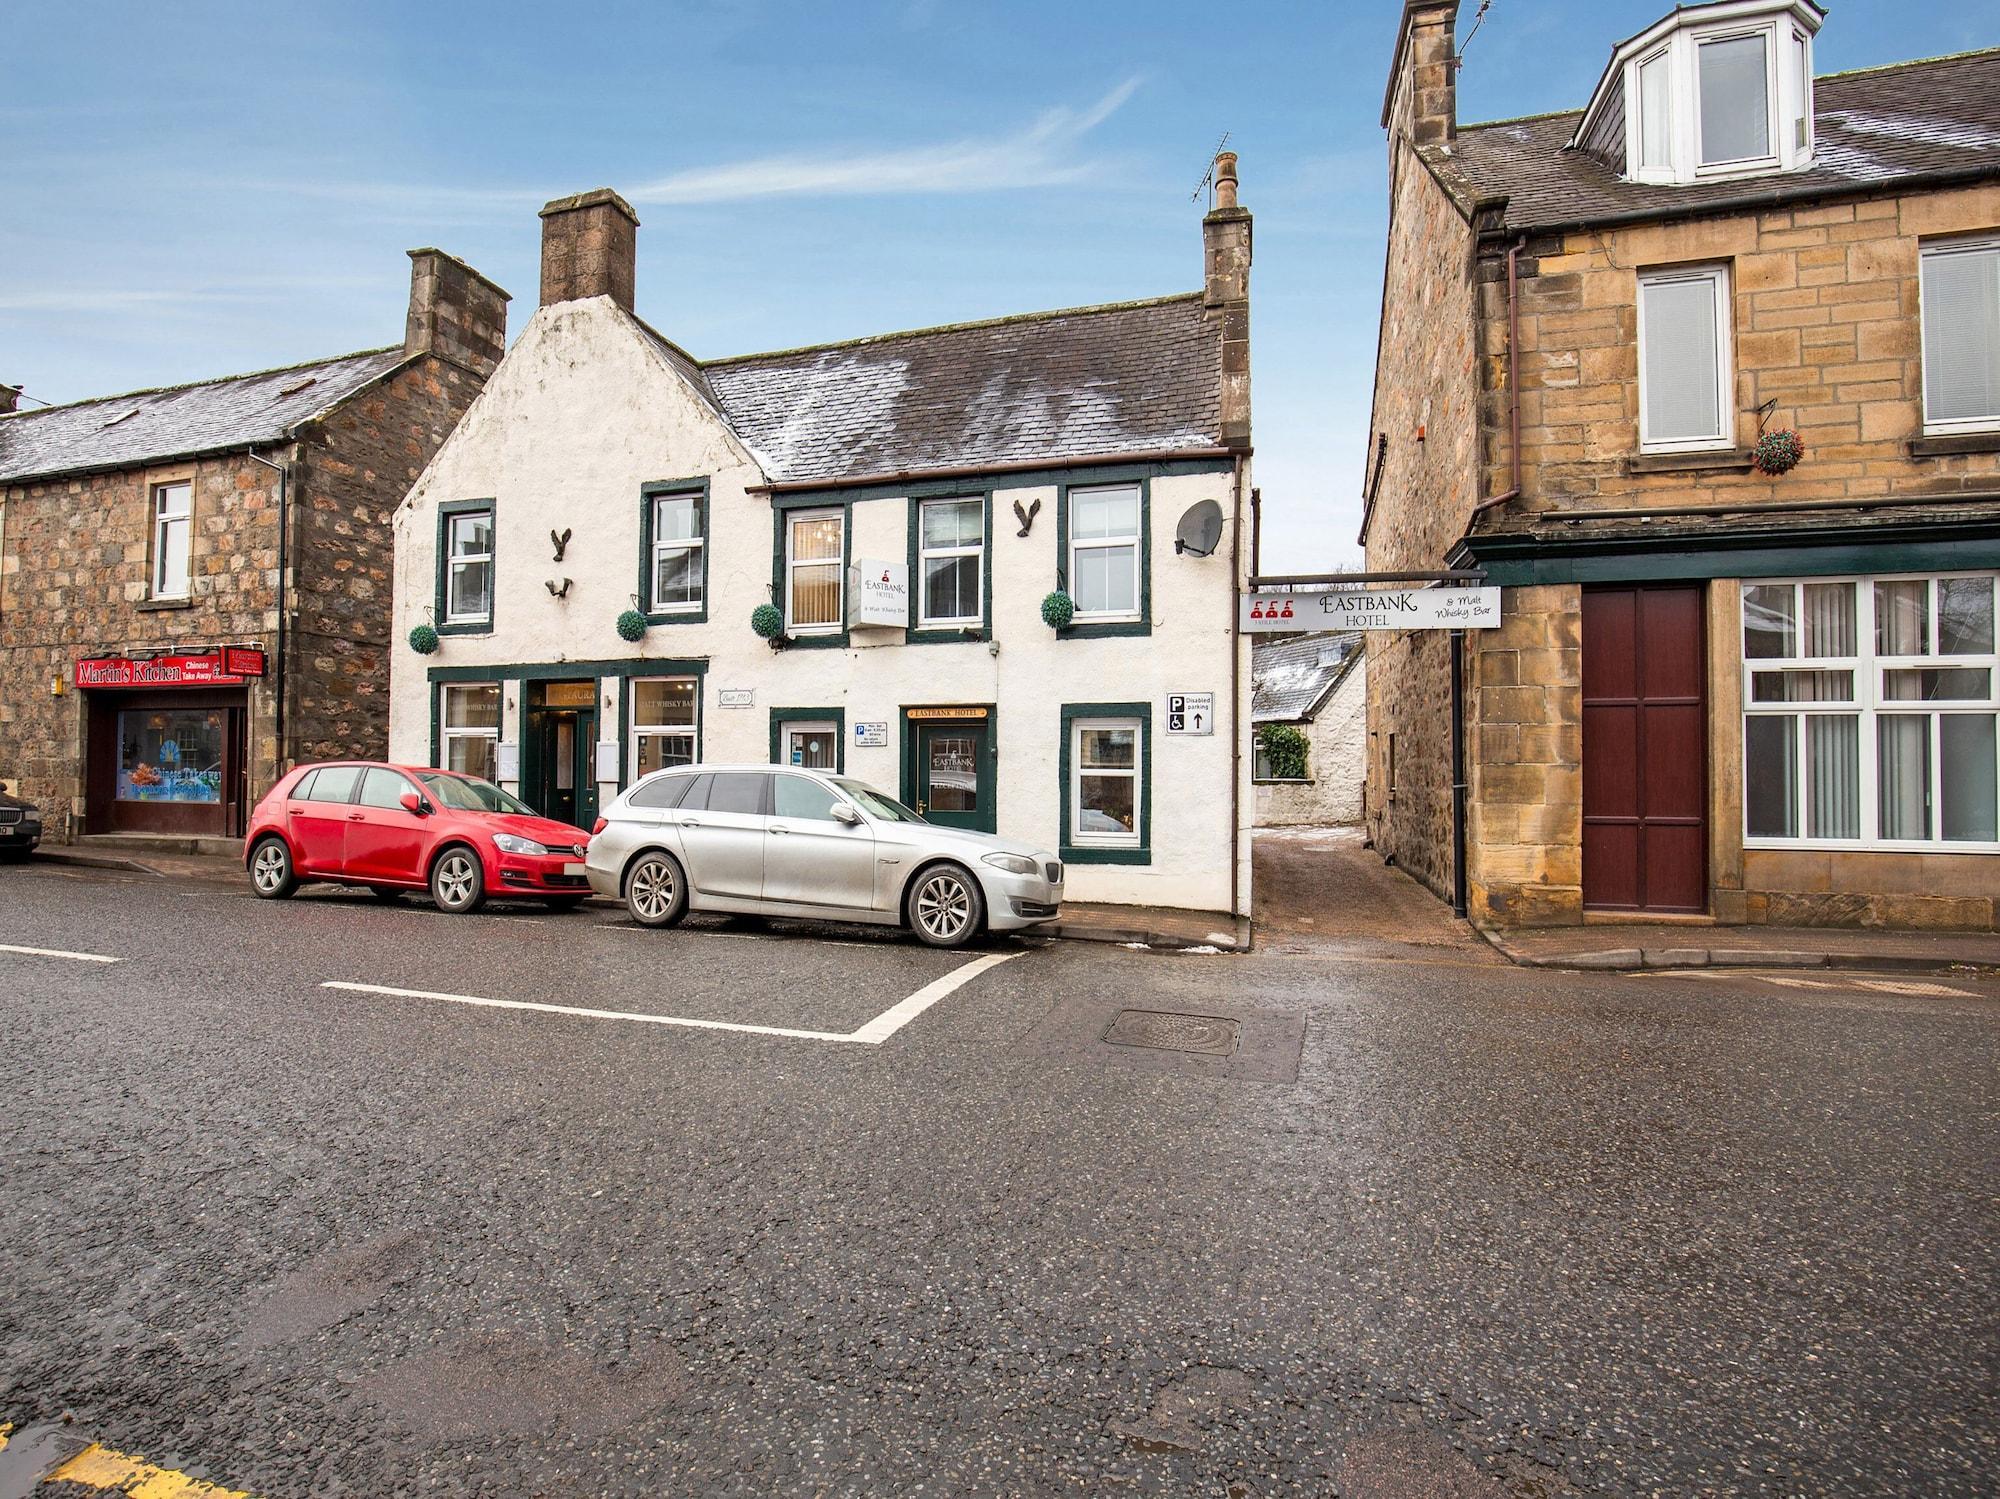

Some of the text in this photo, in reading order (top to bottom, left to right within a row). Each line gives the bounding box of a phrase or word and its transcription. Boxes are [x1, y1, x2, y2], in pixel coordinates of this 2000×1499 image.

[865, 580, 905, 594] EASTBANK
[1319, 593, 1418, 614] EASTBANK
[1458, 596, 1482, 605] Malt
[1435, 605, 1492, 620] Whisky Bar
[1346, 615, 1390, 626] HOTEL
[185, 661, 209, 670] Chinese
[79, 659, 181, 684] Martin's Kitchen
[182, 672, 195, 680] Take
[195, 671, 212, 681] Away
[656, 700, 681, 708] WHISKY
[915, 709, 952, 717] EASTBANK
[933, 757, 974, 767] EASTBANK
